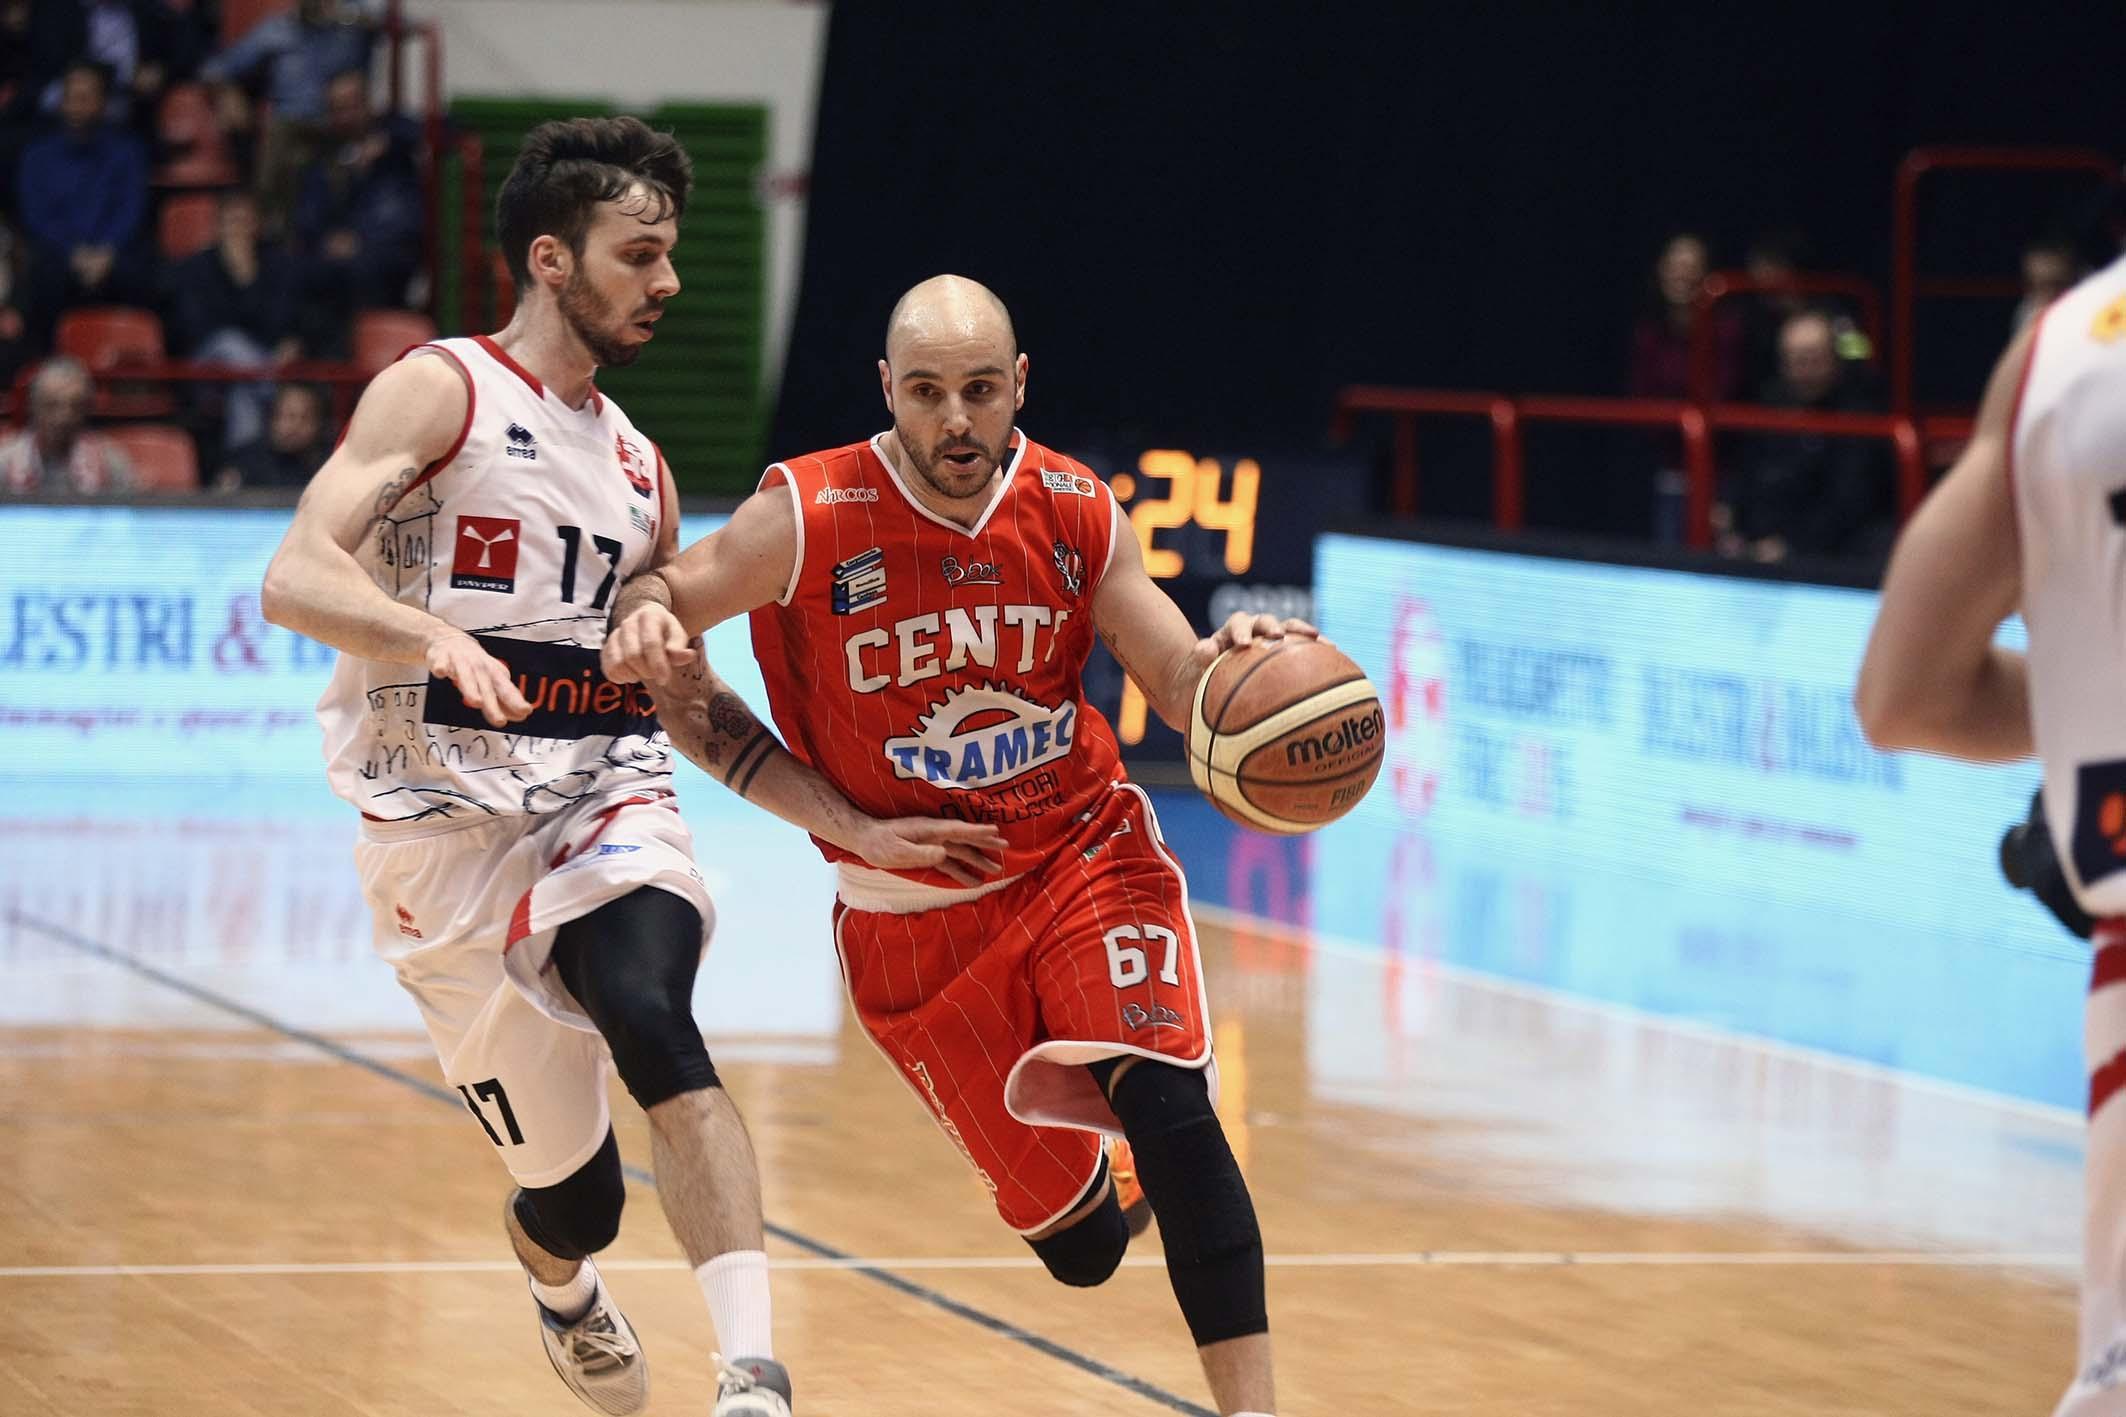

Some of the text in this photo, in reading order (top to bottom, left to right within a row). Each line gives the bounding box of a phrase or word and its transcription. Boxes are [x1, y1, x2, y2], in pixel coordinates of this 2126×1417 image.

[557, 525, 623, 611] 17
[0, 594, 195, 667] ESTRI
[892, 707, 1074, 783] TRAMEC
[1286, 708, 1384, 767] molten
[1102, 923, 1180, 989] 67
[457, 1077, 527, 1147] 17
